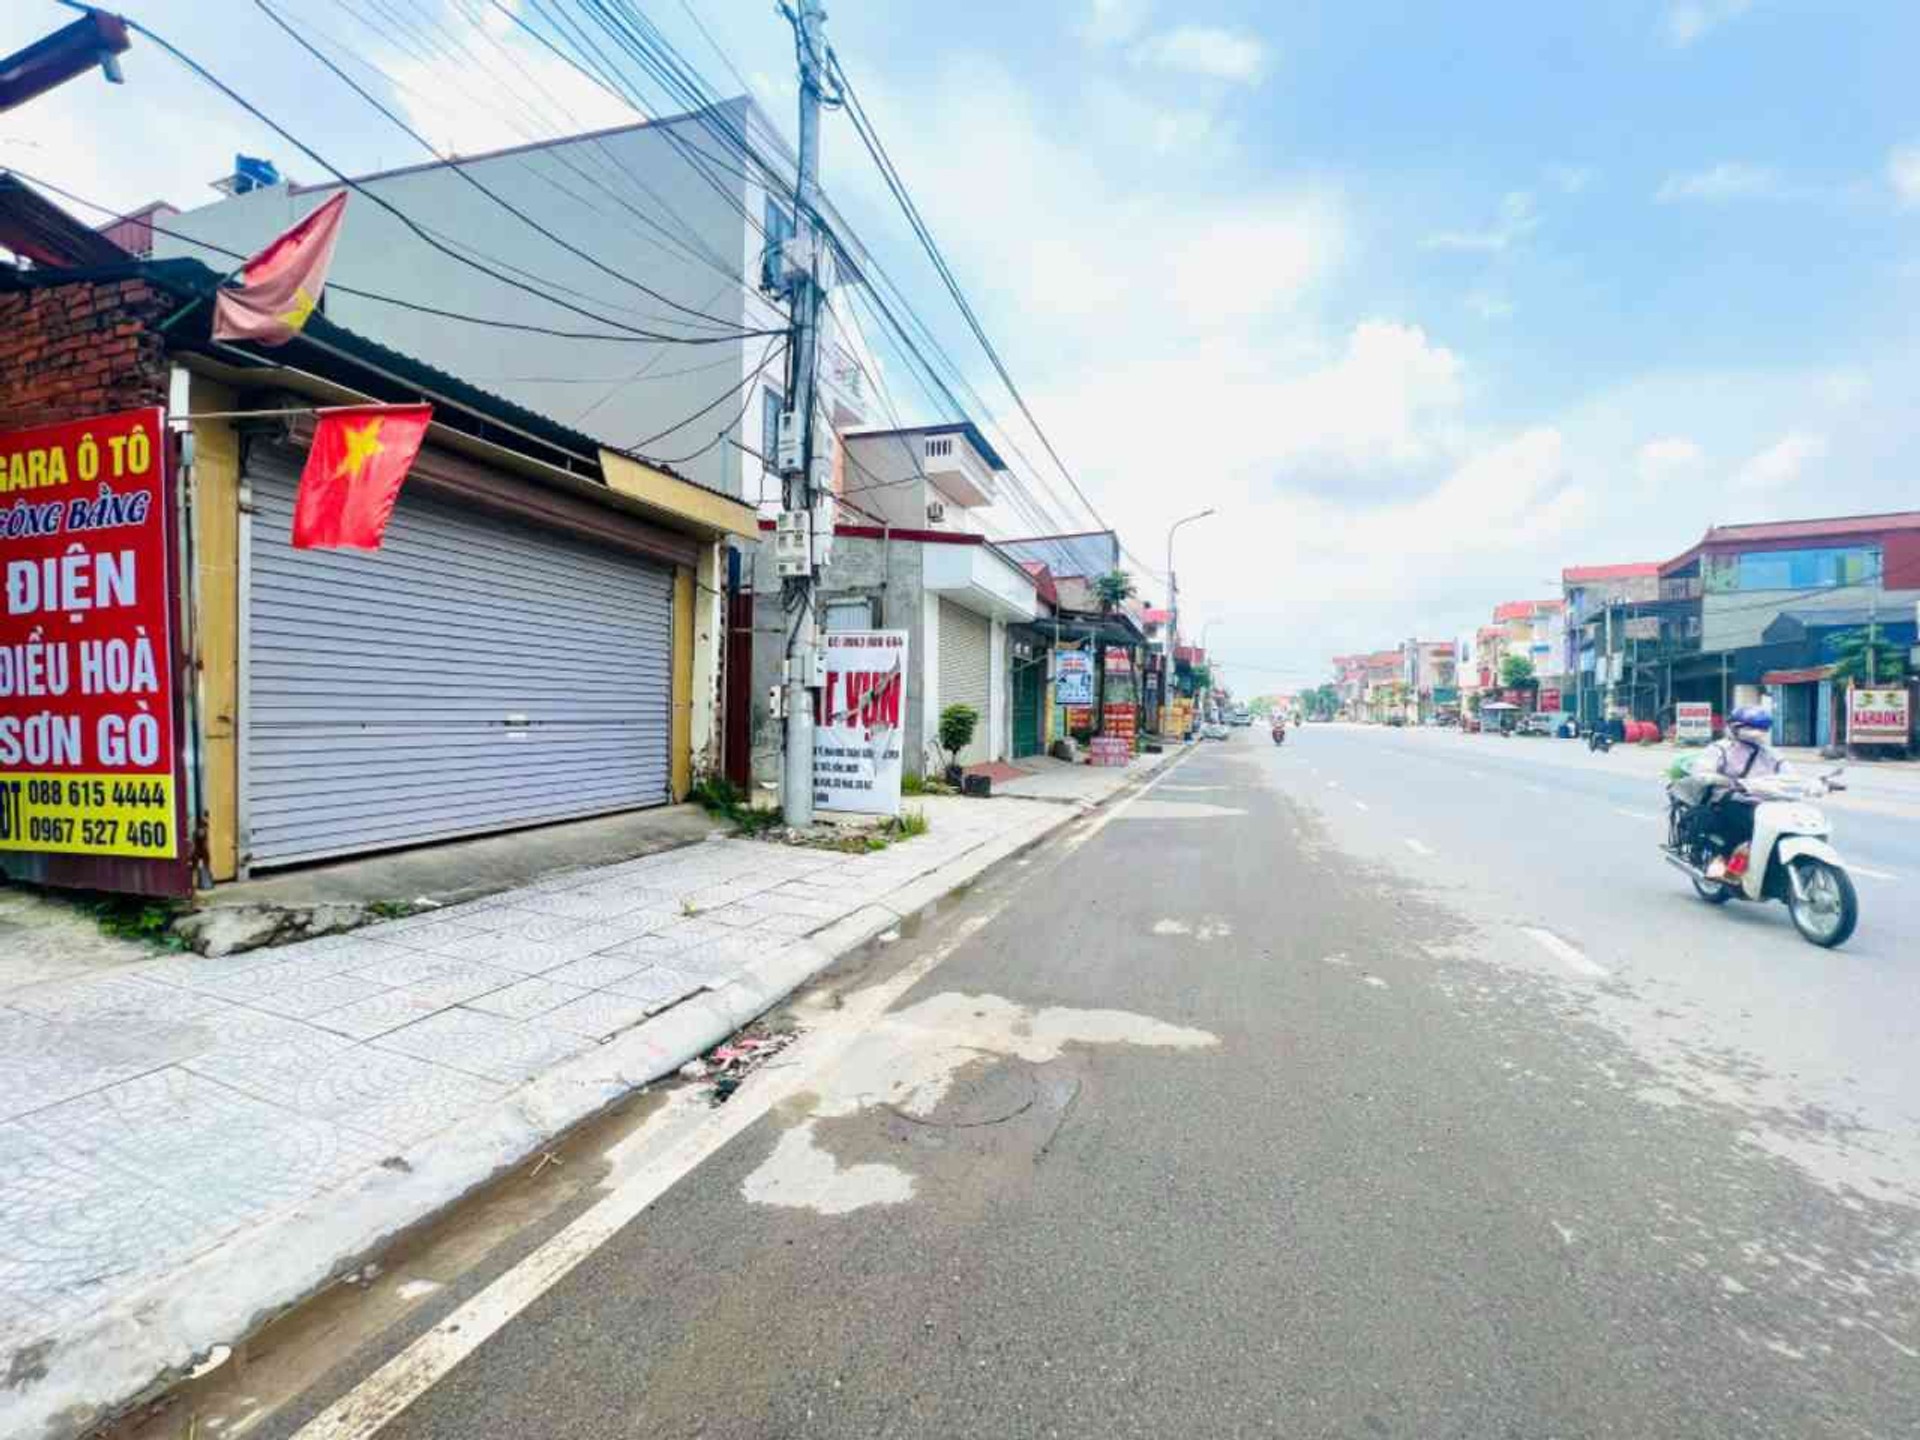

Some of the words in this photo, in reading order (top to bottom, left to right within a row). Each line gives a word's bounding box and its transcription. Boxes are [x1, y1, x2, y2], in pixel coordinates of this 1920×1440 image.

[78, 432, 99, 481] Ô
[108, 424, 150, 476] TÔ
[6, 543, 136, 623] ĐIỆN
[80, 626, 158, 694] HOÀ
[0, 709, 82, 767] SƠN
[97, 700, 159, 767] GÒ
[29, 780, 62, 806] 088
[69, 782, 105, 807] 615
[113, 783, 165, 808] 4444
[30, 816, 74, 842] 0967
[82, 820, 118, 845] 527
[127, 822, 167, 848] 460
